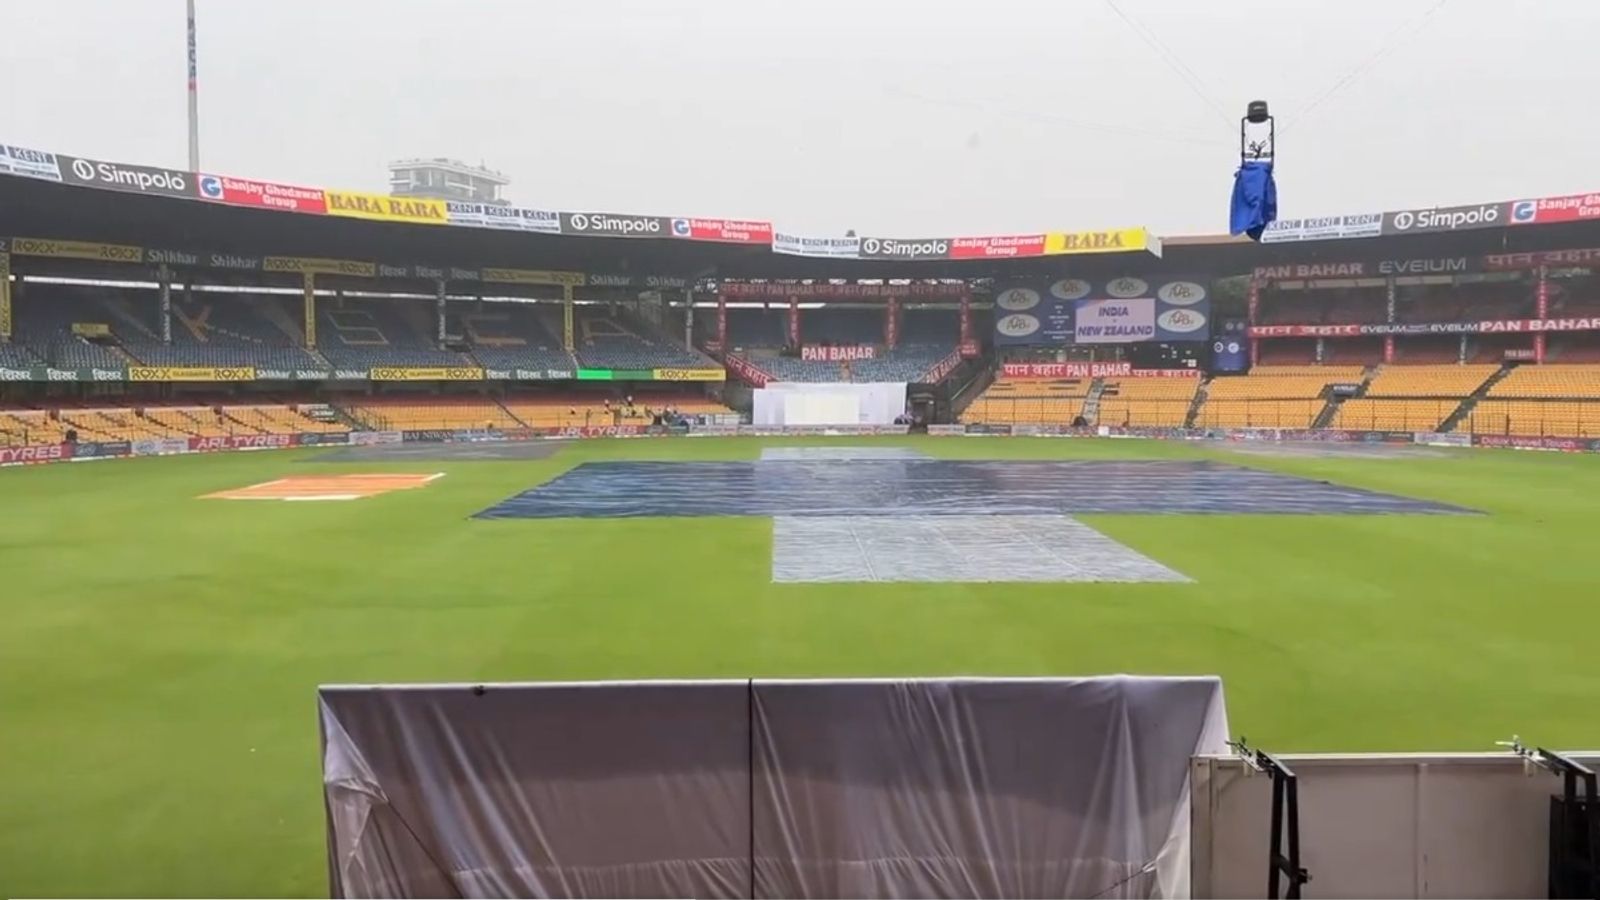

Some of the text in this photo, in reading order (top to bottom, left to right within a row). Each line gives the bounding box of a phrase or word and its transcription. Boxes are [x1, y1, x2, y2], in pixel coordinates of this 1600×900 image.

[98, 164, 186, 190] Simpolo
[223, 178, 323, 200] Sanjay Ghodawat
[262, 194, 298, 208] Group
[1538, 198, 1580, 210] Sanjay
[591, 216, 660, 232] Simpolo
[1416, 206, 1498, 228] Simpolo
[722, 230, 750, 240] Group
[883, 240, 948, 257] Simpolo
[986, 246, 1018, 255] Group
[148, 249, 198, 264] Shikhar
[210, 254, 258, 268] Shikhar
[1254, 263, 1364, 279] PAN BAHAR
[1379, 258, 1467, 274] EVEIUM
[1098, 307, 1130, 317] INDIA
[1077, 326, 1152, 336] NEW ZEALAND
[1360, 325, 1406, 333] EVEIUM
[1430, 322, 1479, 332] EVEIUM
[1480, 320, 1522, 332] PAN
[802, 346, 874, 360] PAN BAHAR
[132, 369, 172, 379] ROXX
[215, 369, 250, 379] ROXX
[373, 370, 408, 378] ROXX
[446, 370, 479, 378] ROXX
[660, 370, 689, 379] ROXX
[1004, 363, 1064, 376] पान बहार
[1066, 363, 1131, 377] PAN BAHAR
[586, 426, 638, 436] TYRES
[197, 436, 230, 448] ARL
[232, 434, 290, 446] TYRES
[0, 446, 62, 460] TYRES
